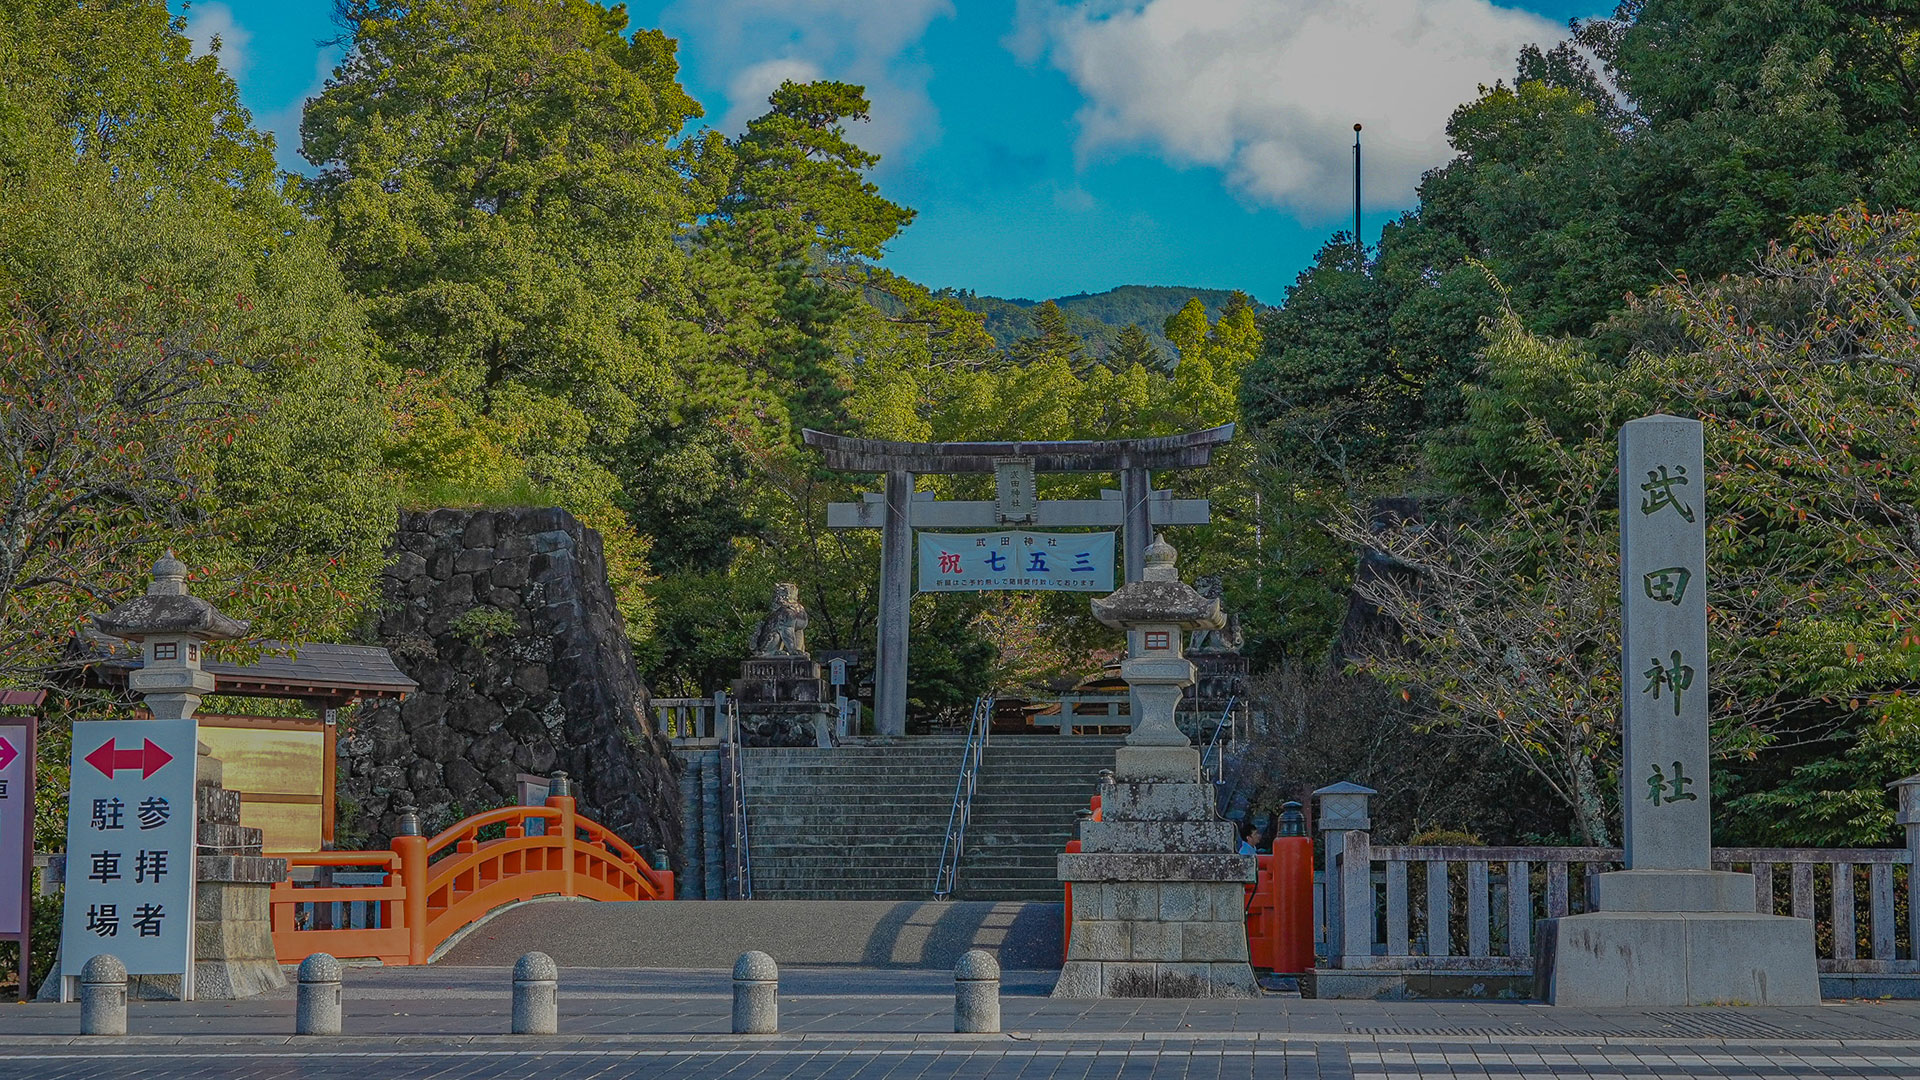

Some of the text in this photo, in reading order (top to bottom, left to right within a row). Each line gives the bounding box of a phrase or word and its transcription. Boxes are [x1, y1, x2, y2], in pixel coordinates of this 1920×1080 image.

[976, 536, 1057, 548] 武田神社
[1010, 470, 1021, 508] 武田神社
[1639, 465, 1696, 807] 武田神社
[86, 797, 125, 938] 駐車場
[132, 796, 170, 938] 参拝者
